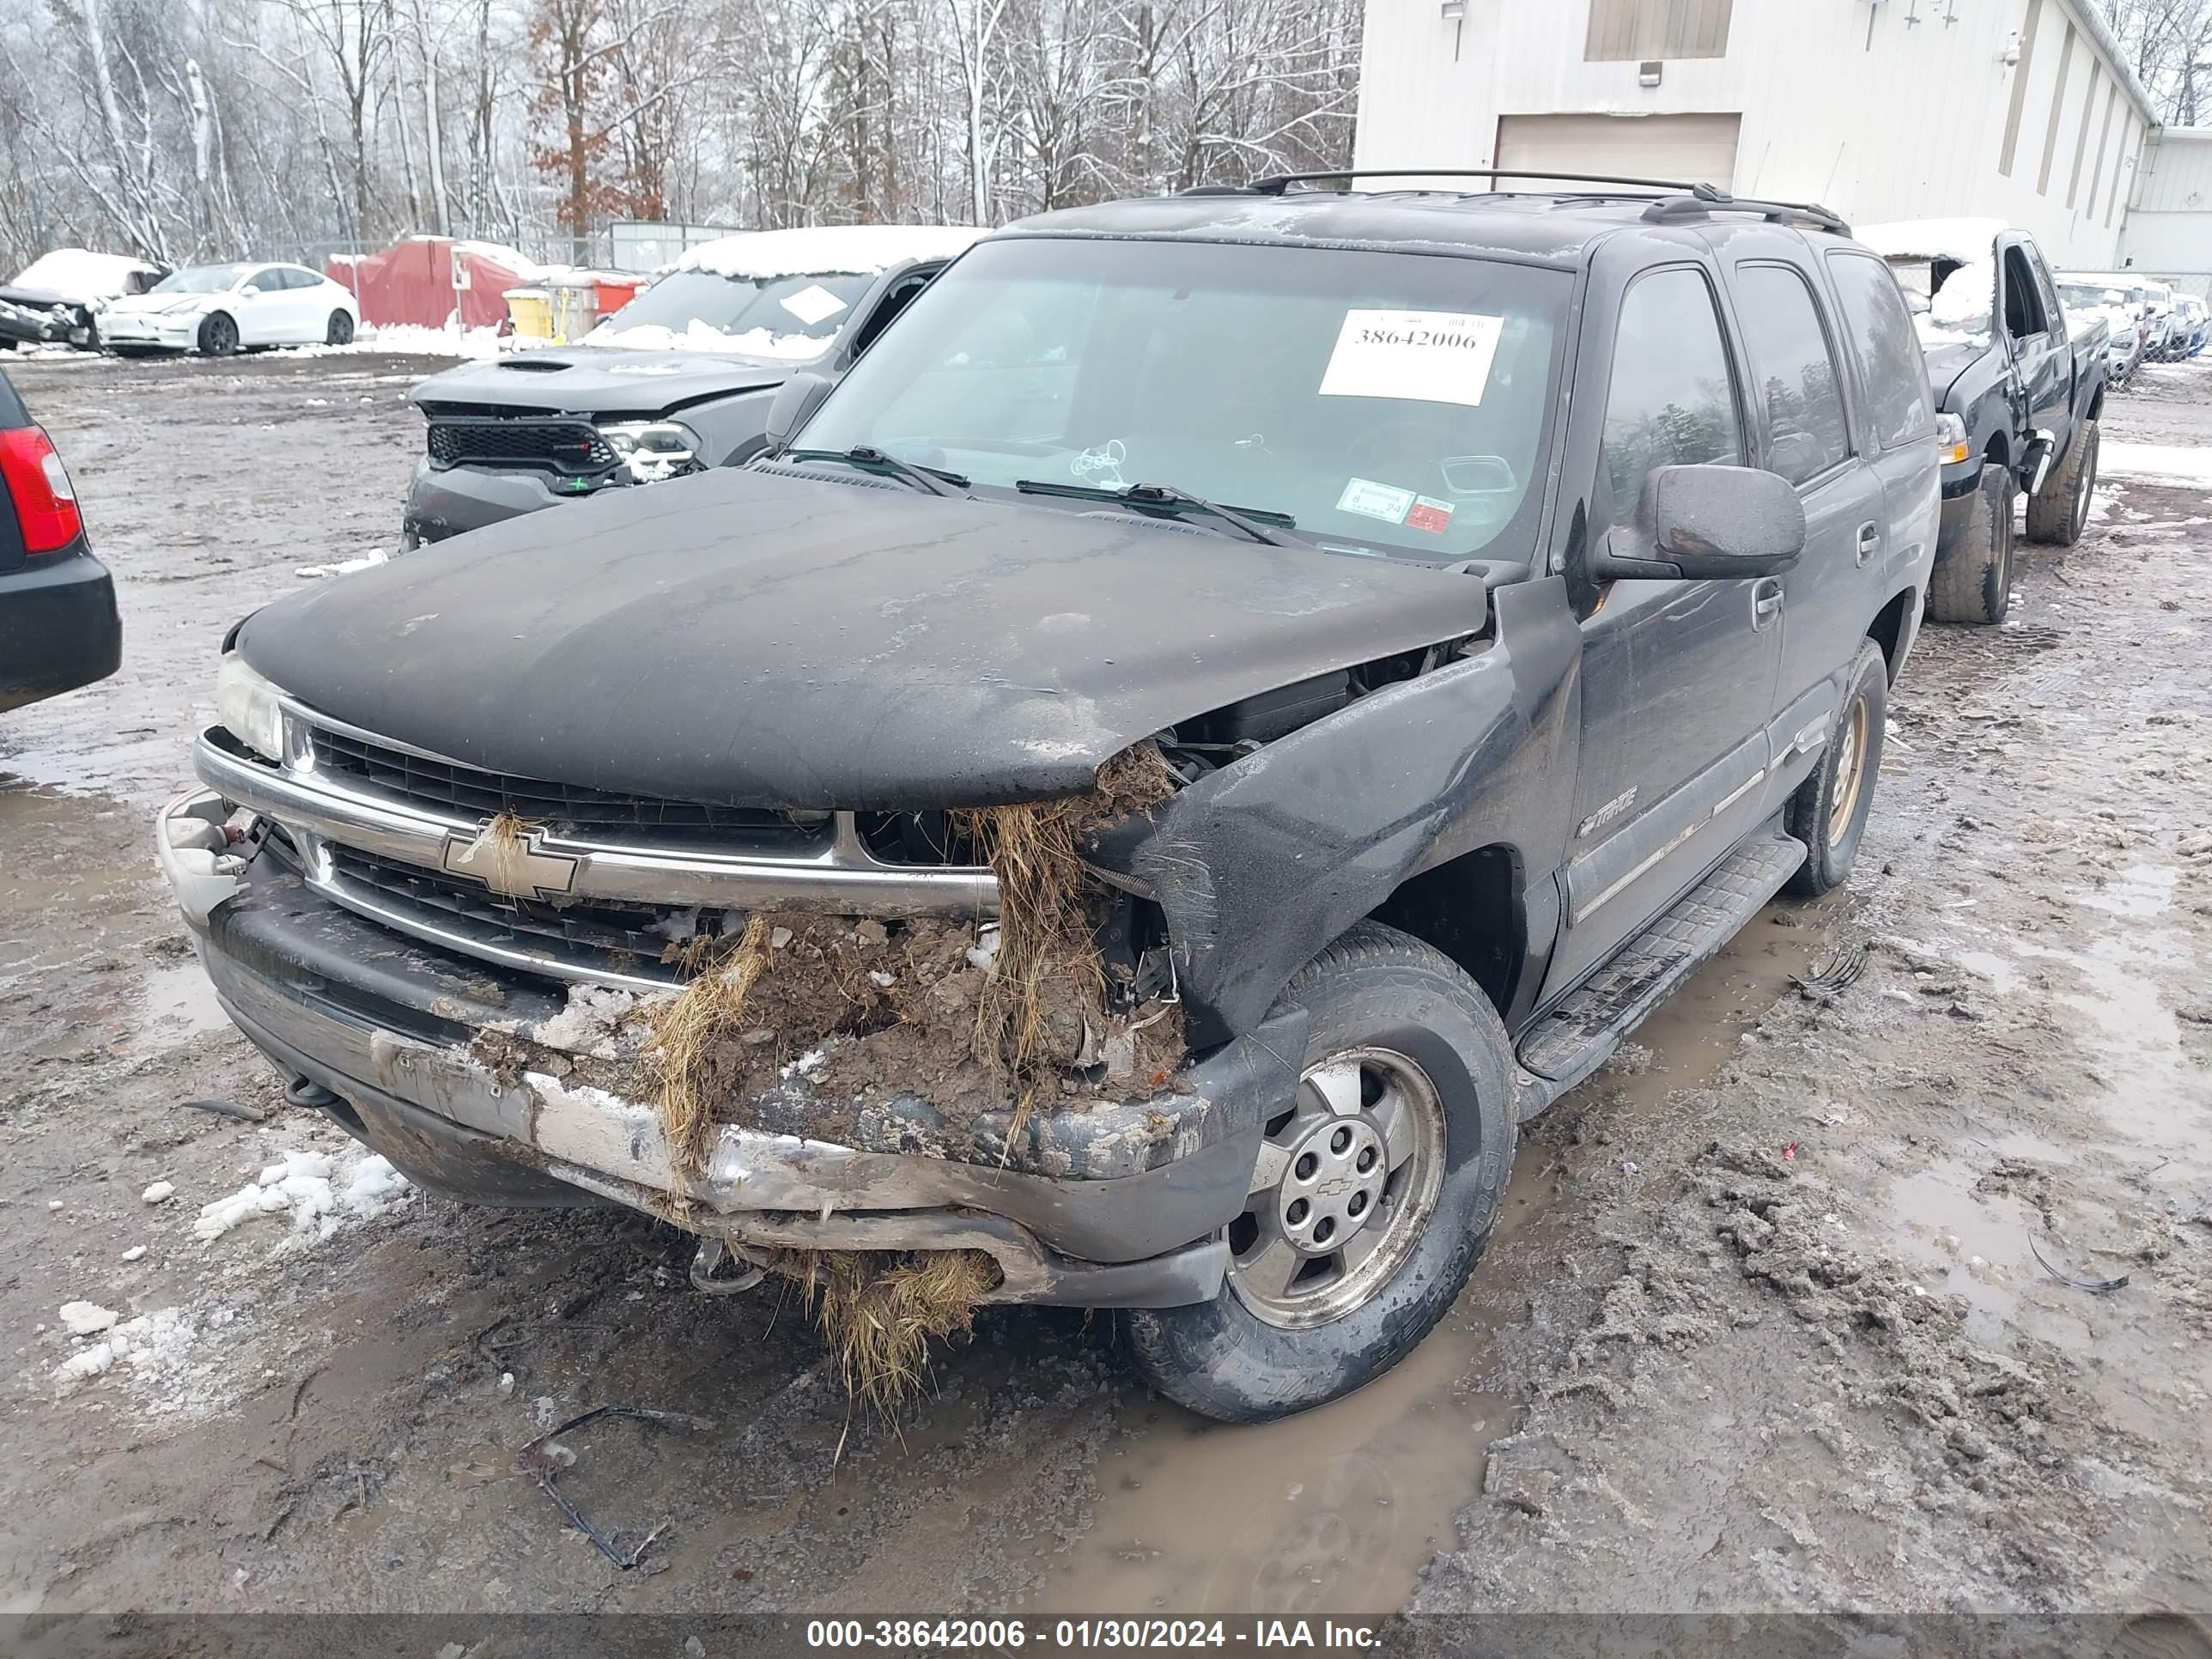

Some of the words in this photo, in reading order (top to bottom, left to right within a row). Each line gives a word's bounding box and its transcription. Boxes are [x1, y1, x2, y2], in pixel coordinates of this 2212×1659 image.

[1355, 329, 1476, 349] 38642006
[1352, 495, 1361, 503] 8
[1385, 502, 1401, 514] 24
